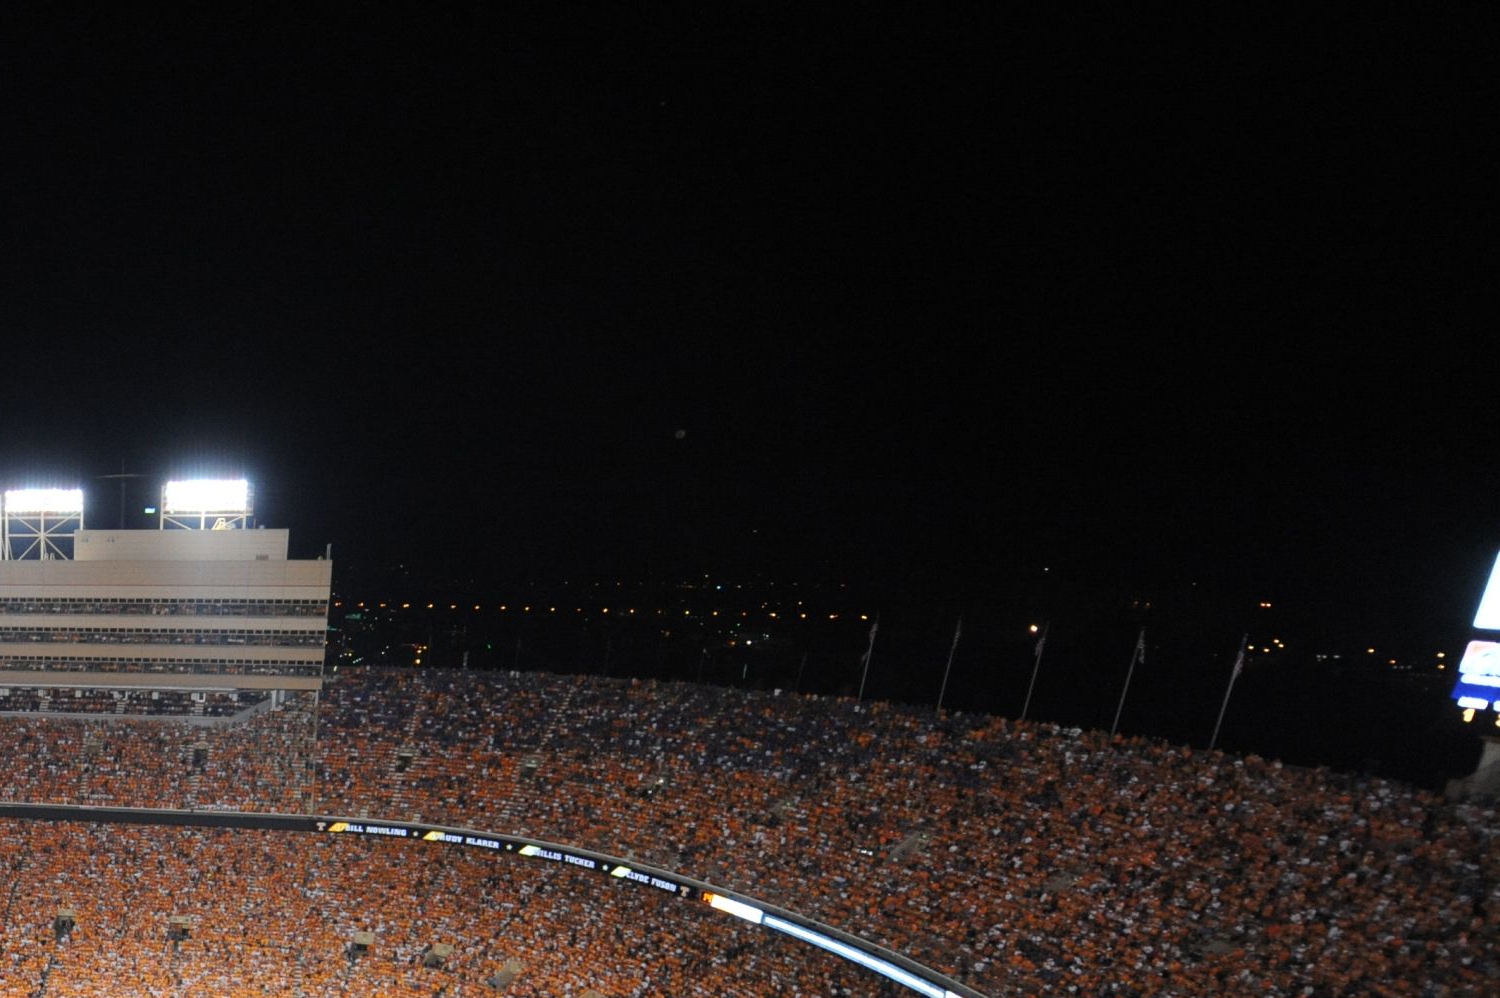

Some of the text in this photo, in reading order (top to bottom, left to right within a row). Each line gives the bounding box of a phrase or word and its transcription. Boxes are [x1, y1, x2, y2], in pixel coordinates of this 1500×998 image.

[345, 824, 363, 833] BILL
[366, 826, 407, 837] NOWLING
[439, 832, 463, 844] RUDY
[466, 836, 500, 849] KLARER
[564, 854, 595, 869] TUCKER
[651, 877, 677, 892] FUSON
